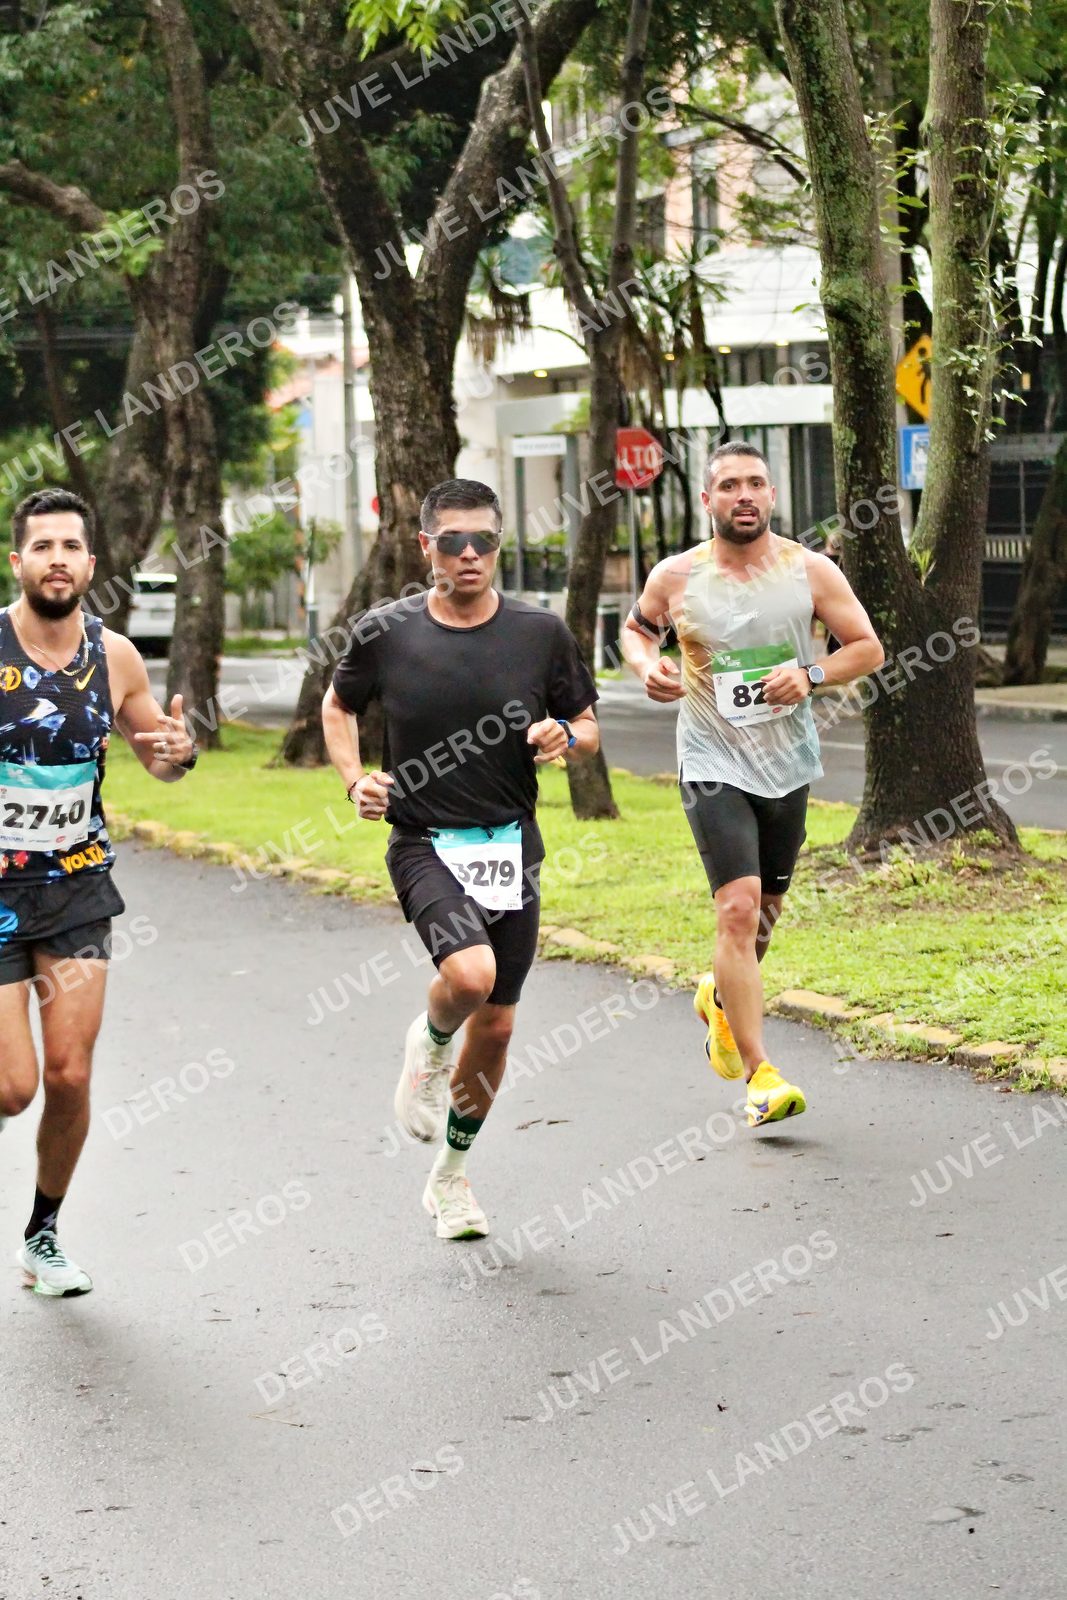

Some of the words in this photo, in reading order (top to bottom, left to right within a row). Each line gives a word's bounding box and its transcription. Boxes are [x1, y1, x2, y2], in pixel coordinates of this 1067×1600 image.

[732, 682, 768, 708] 82
[2, 799, 86, 830] 2740
[451, 859, 516, 887] 3279
